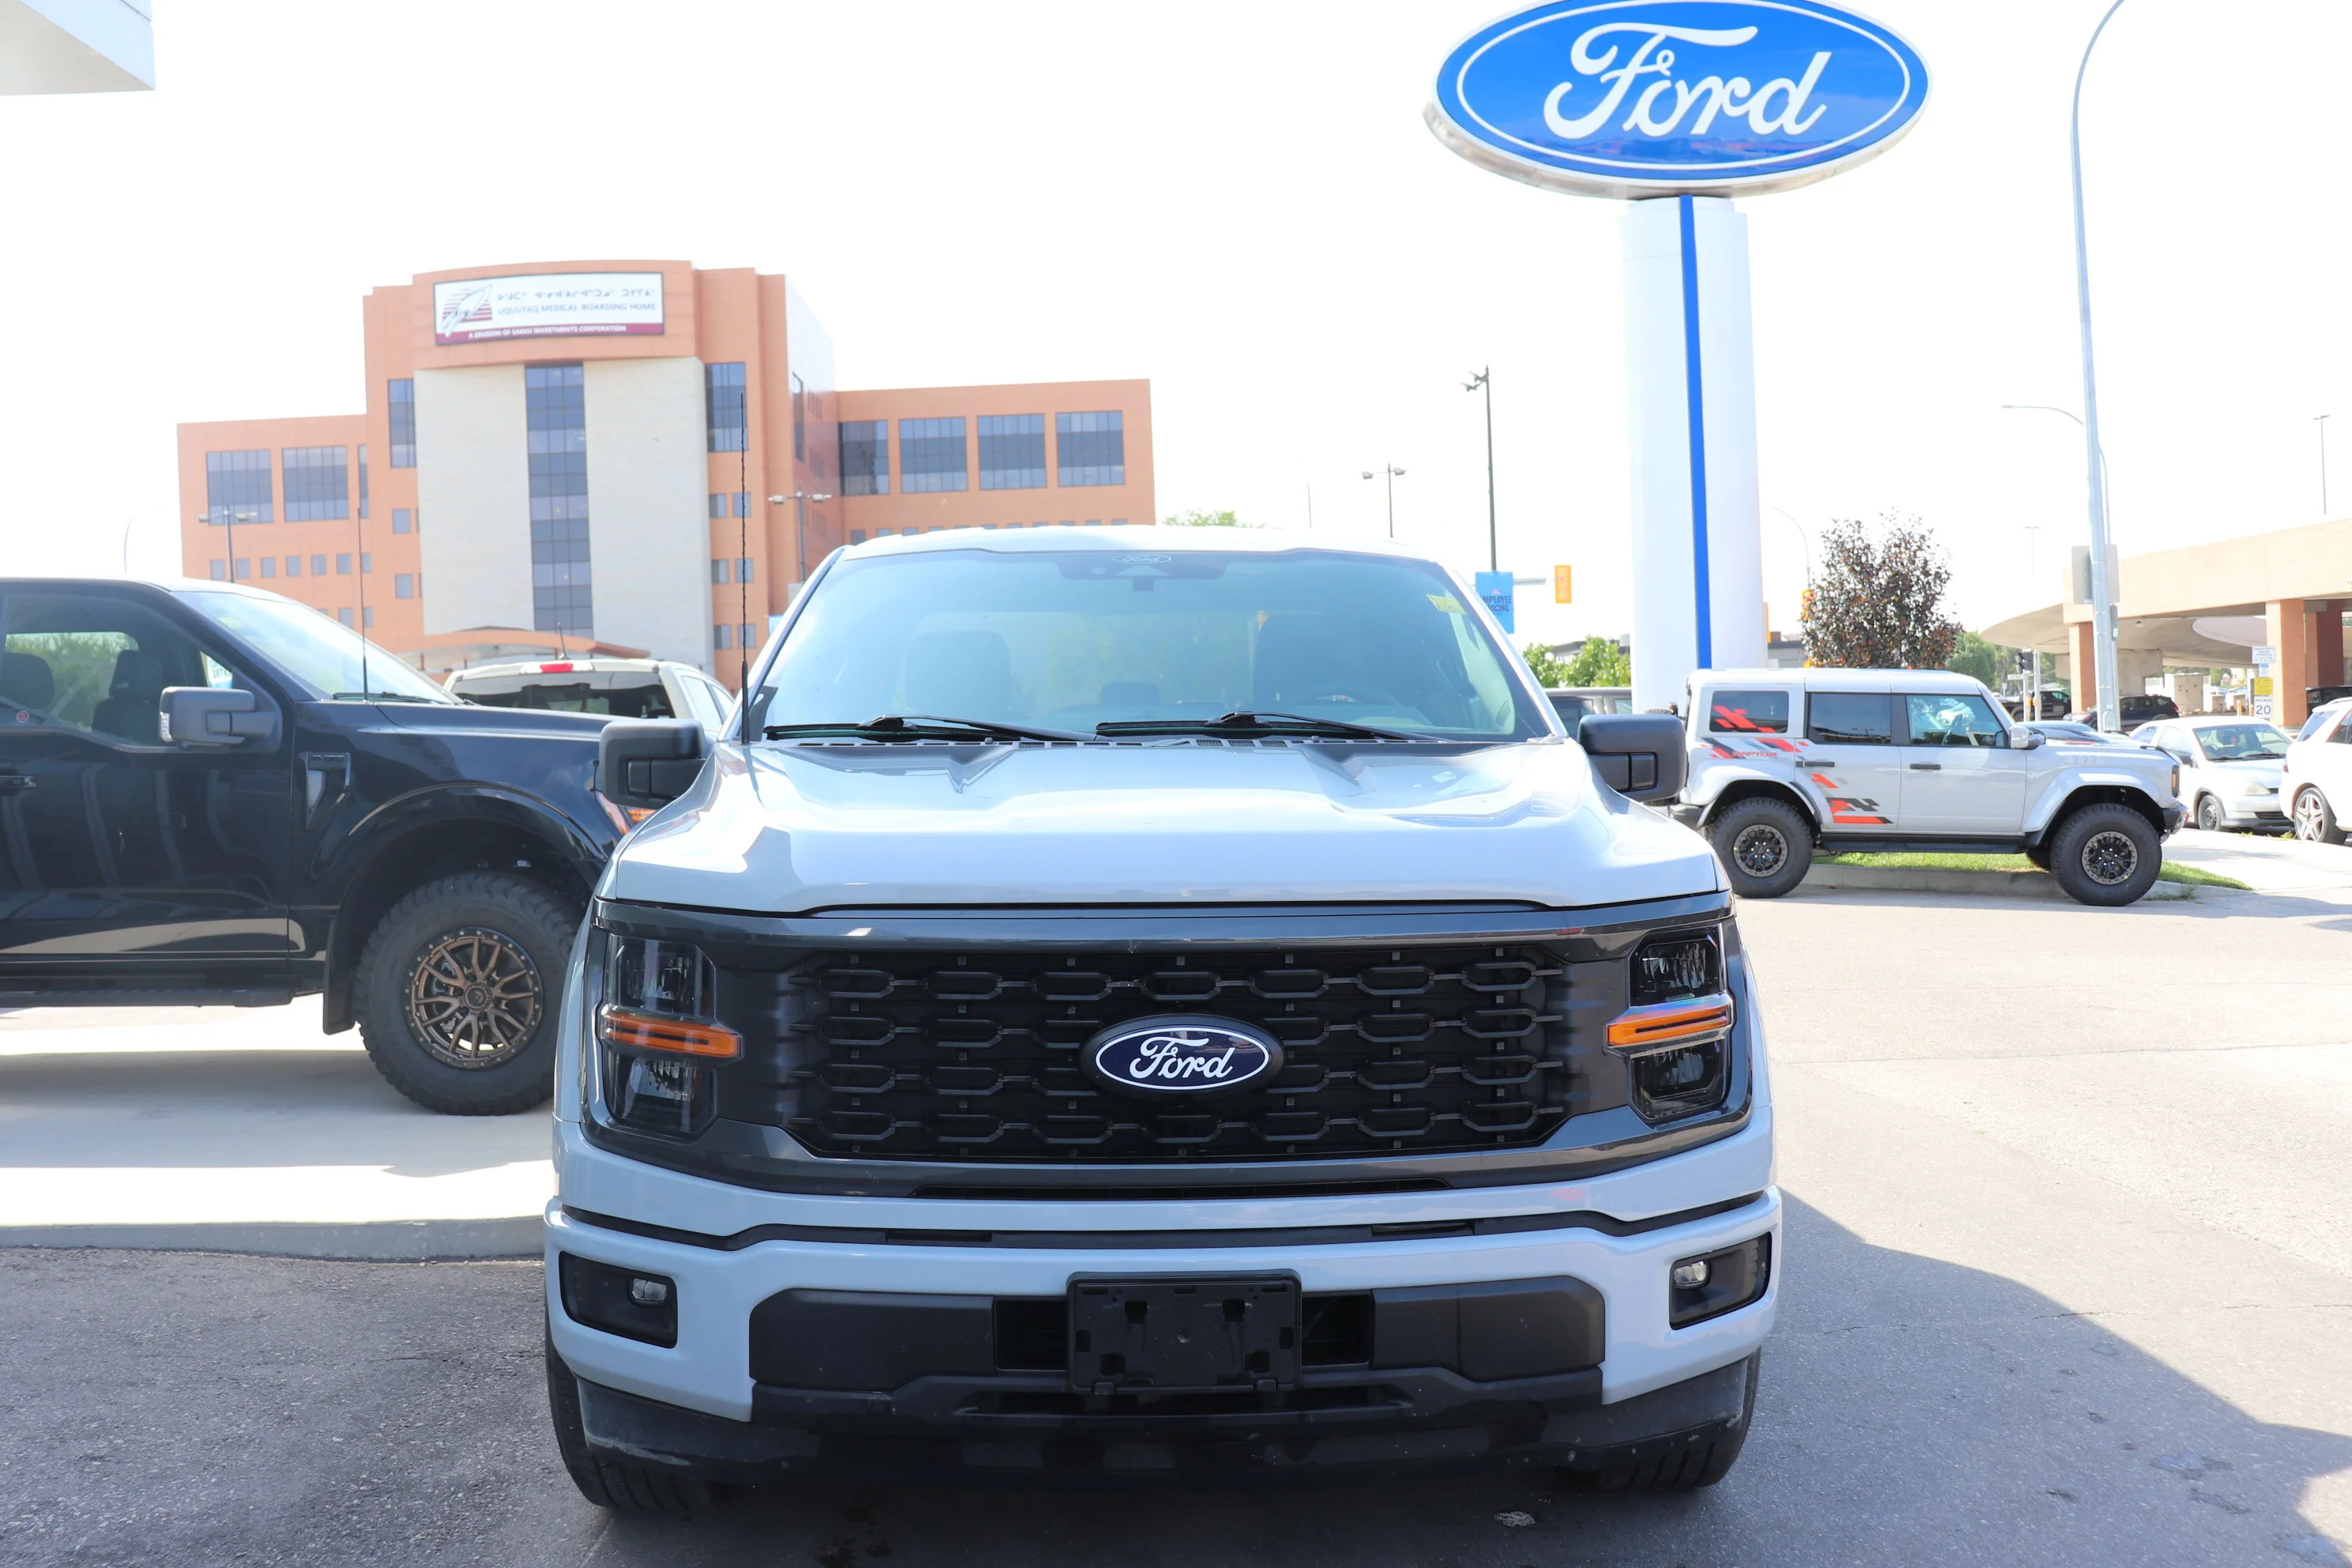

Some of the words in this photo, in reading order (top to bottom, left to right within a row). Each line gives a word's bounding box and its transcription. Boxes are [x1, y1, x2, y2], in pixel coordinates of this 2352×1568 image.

[1544, 22, 1832, 139] Ford
[541, 303, 578, 313] MEDICAL
[533, 325, 578, 334] INVESTMENTS
[1481, 595, 1512, 604] MPLOYEE
[1487, 604, 1510, 612] RICING
[2256, 704, 2271, 715] 20
[1129, 1036, 1235, 1079] Ford
